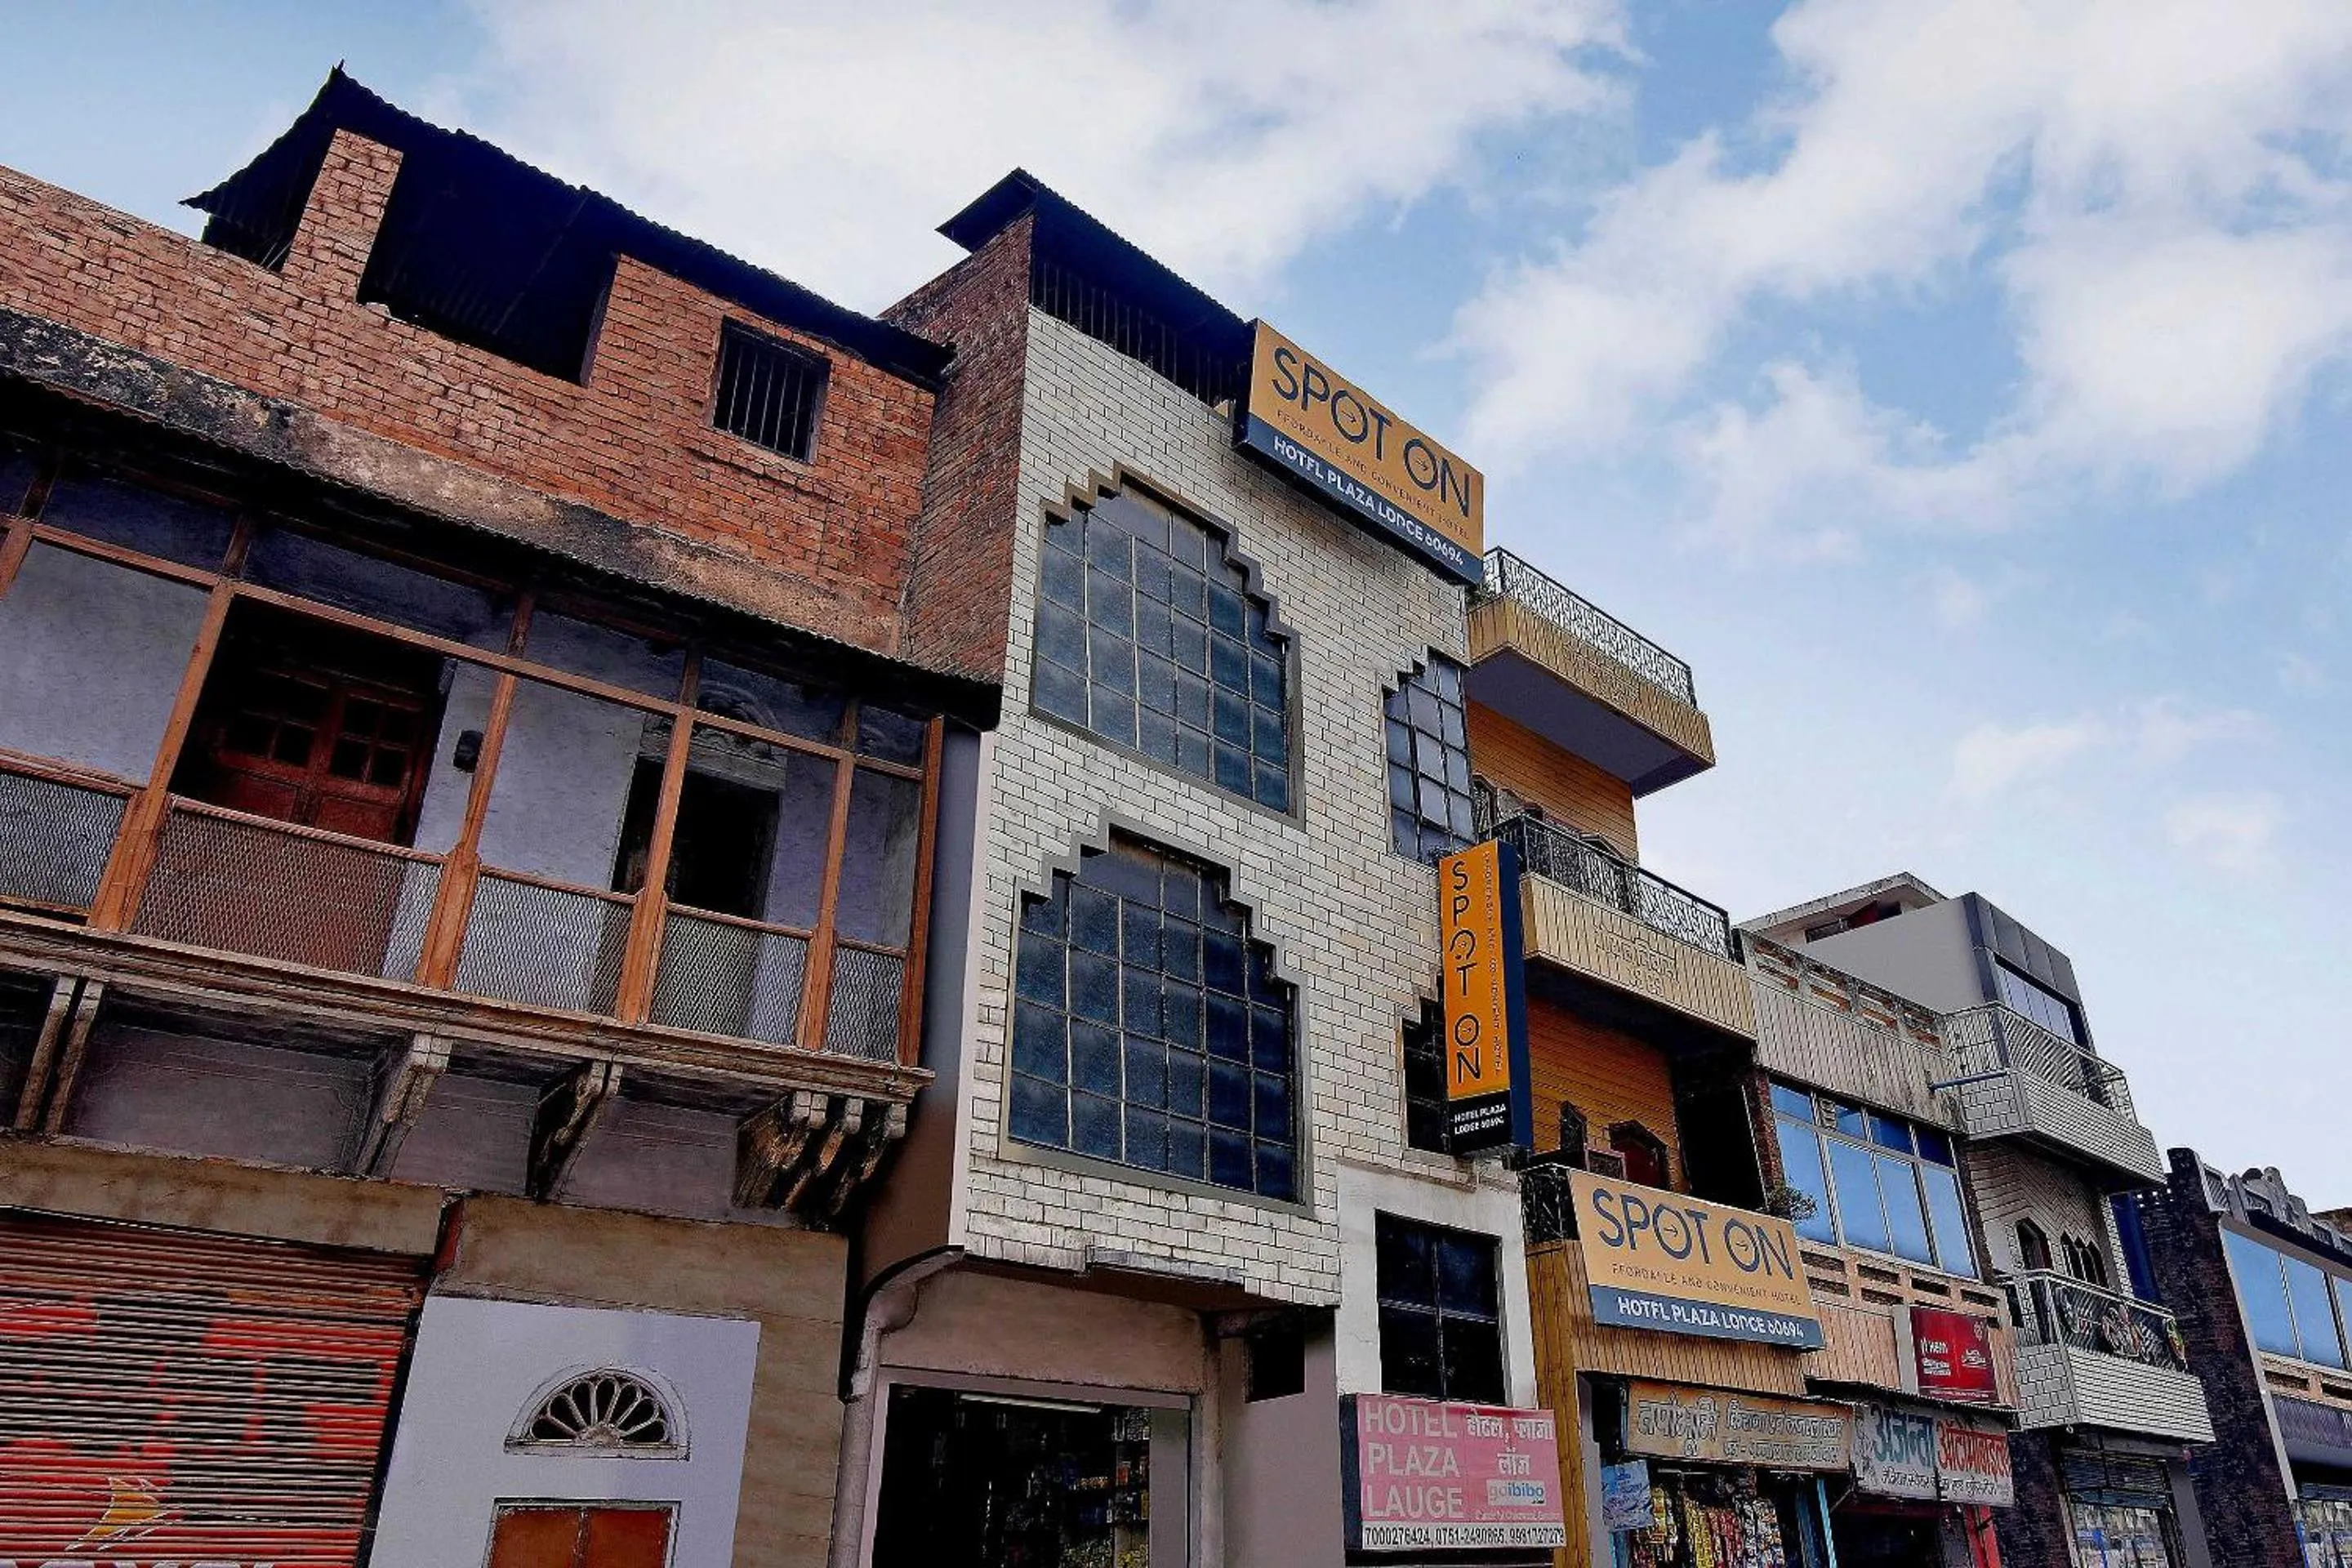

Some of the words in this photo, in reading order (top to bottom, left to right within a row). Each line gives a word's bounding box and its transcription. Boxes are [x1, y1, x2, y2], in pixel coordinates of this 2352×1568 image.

[1272, 346, 1392, 461] SPOT
[1403, 438, 1469, 518] ON
[1327, 469, 1375, 512] PLAZA
[1450, 860, 1477, 996] SPOT
[1454, 1013, 1481, 1085] ON
[1592, 1187, 1711, 1265] SPOT
[1724, 1218, 1793, 1281] ON
[1671, 1303, 1721, 1327] PLAZA
[1365, 1402, 1458, 1439] HOTEL
[1367, 1442, 1460, 1477] PLAZA
[1366, 1484, 1465, 1519] LAUGE
[1489, 1482, 1544, 1501] goibibo
